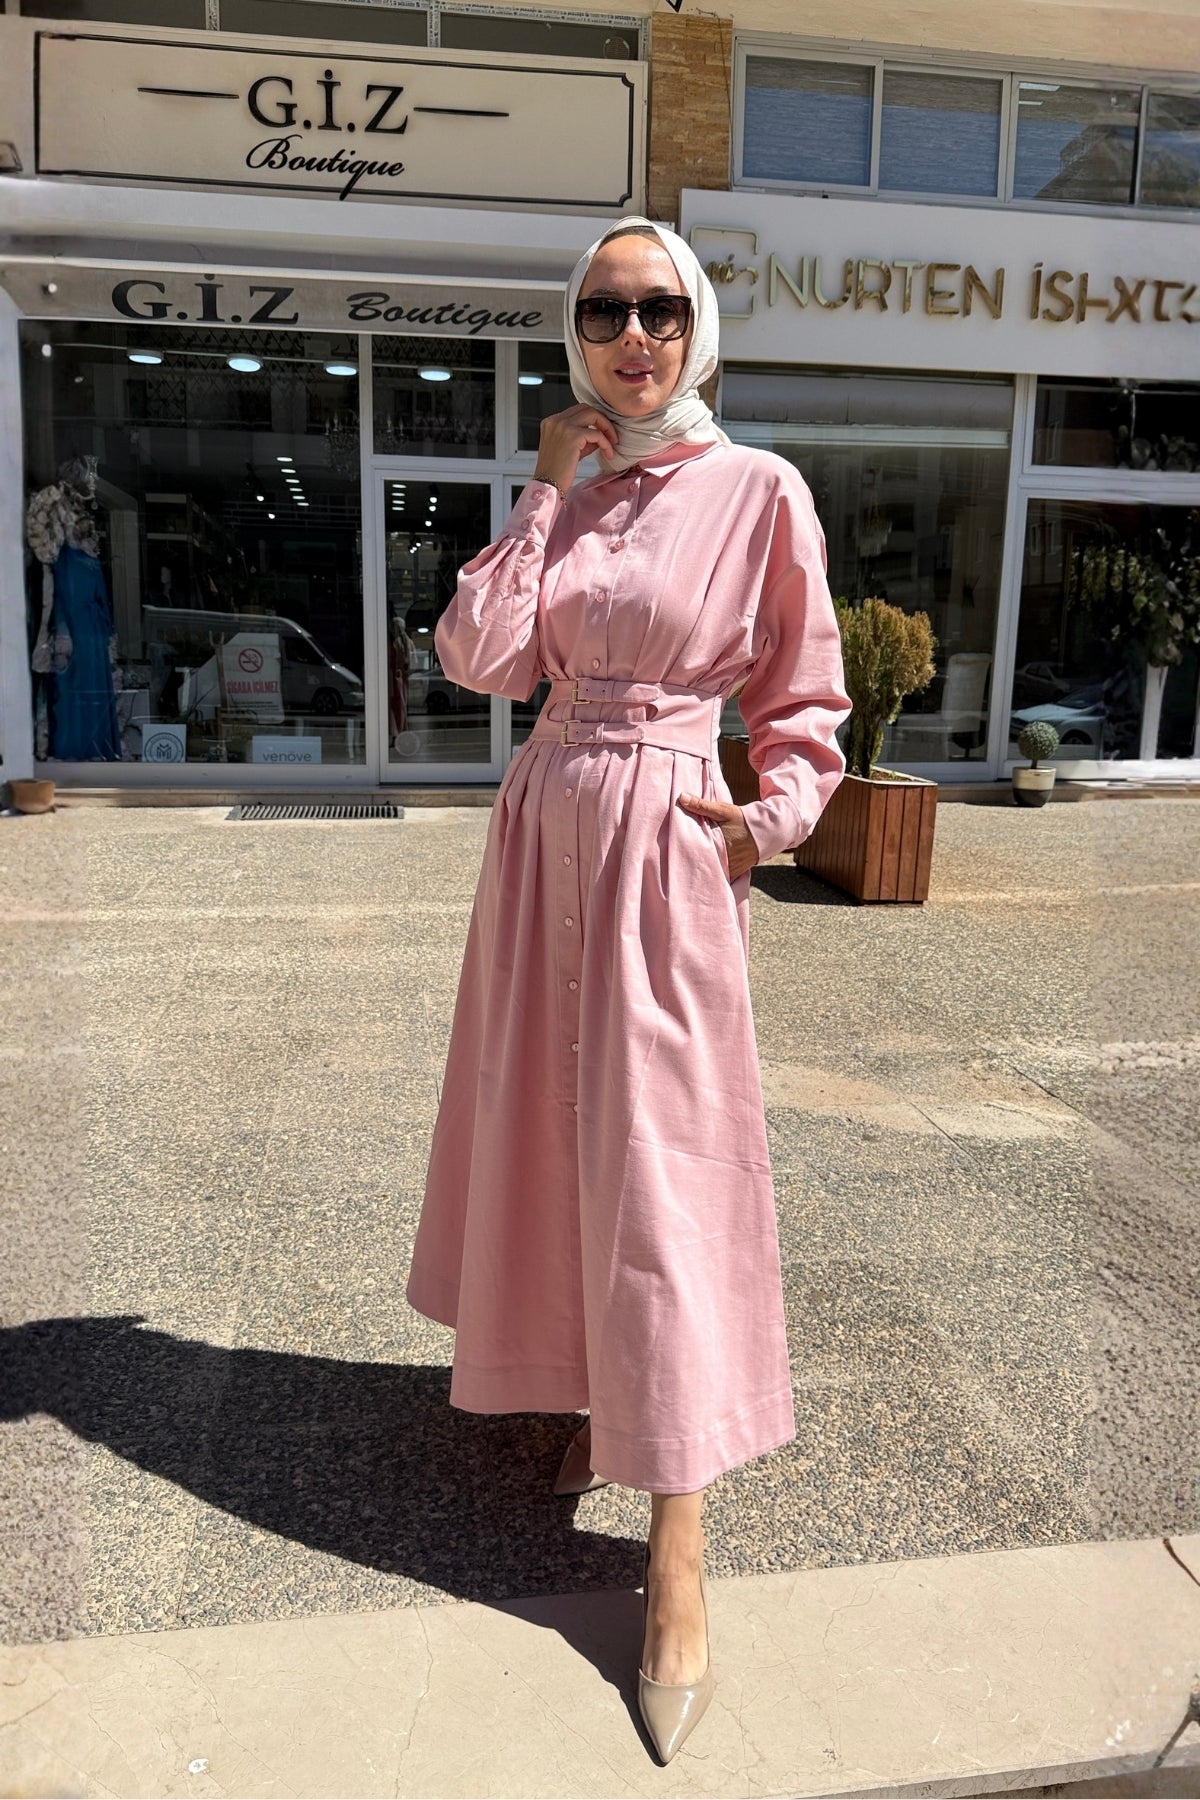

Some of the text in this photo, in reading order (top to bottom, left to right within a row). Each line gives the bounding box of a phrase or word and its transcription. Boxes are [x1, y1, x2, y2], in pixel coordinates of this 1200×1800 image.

[247, 69, 408, 135] G.İ.Z
[245, 134, 405, 201] Boutique
[111, 273, 543, 335] G.İ.Z Boutique
[768, 252, 1006, 321] NURTEN
